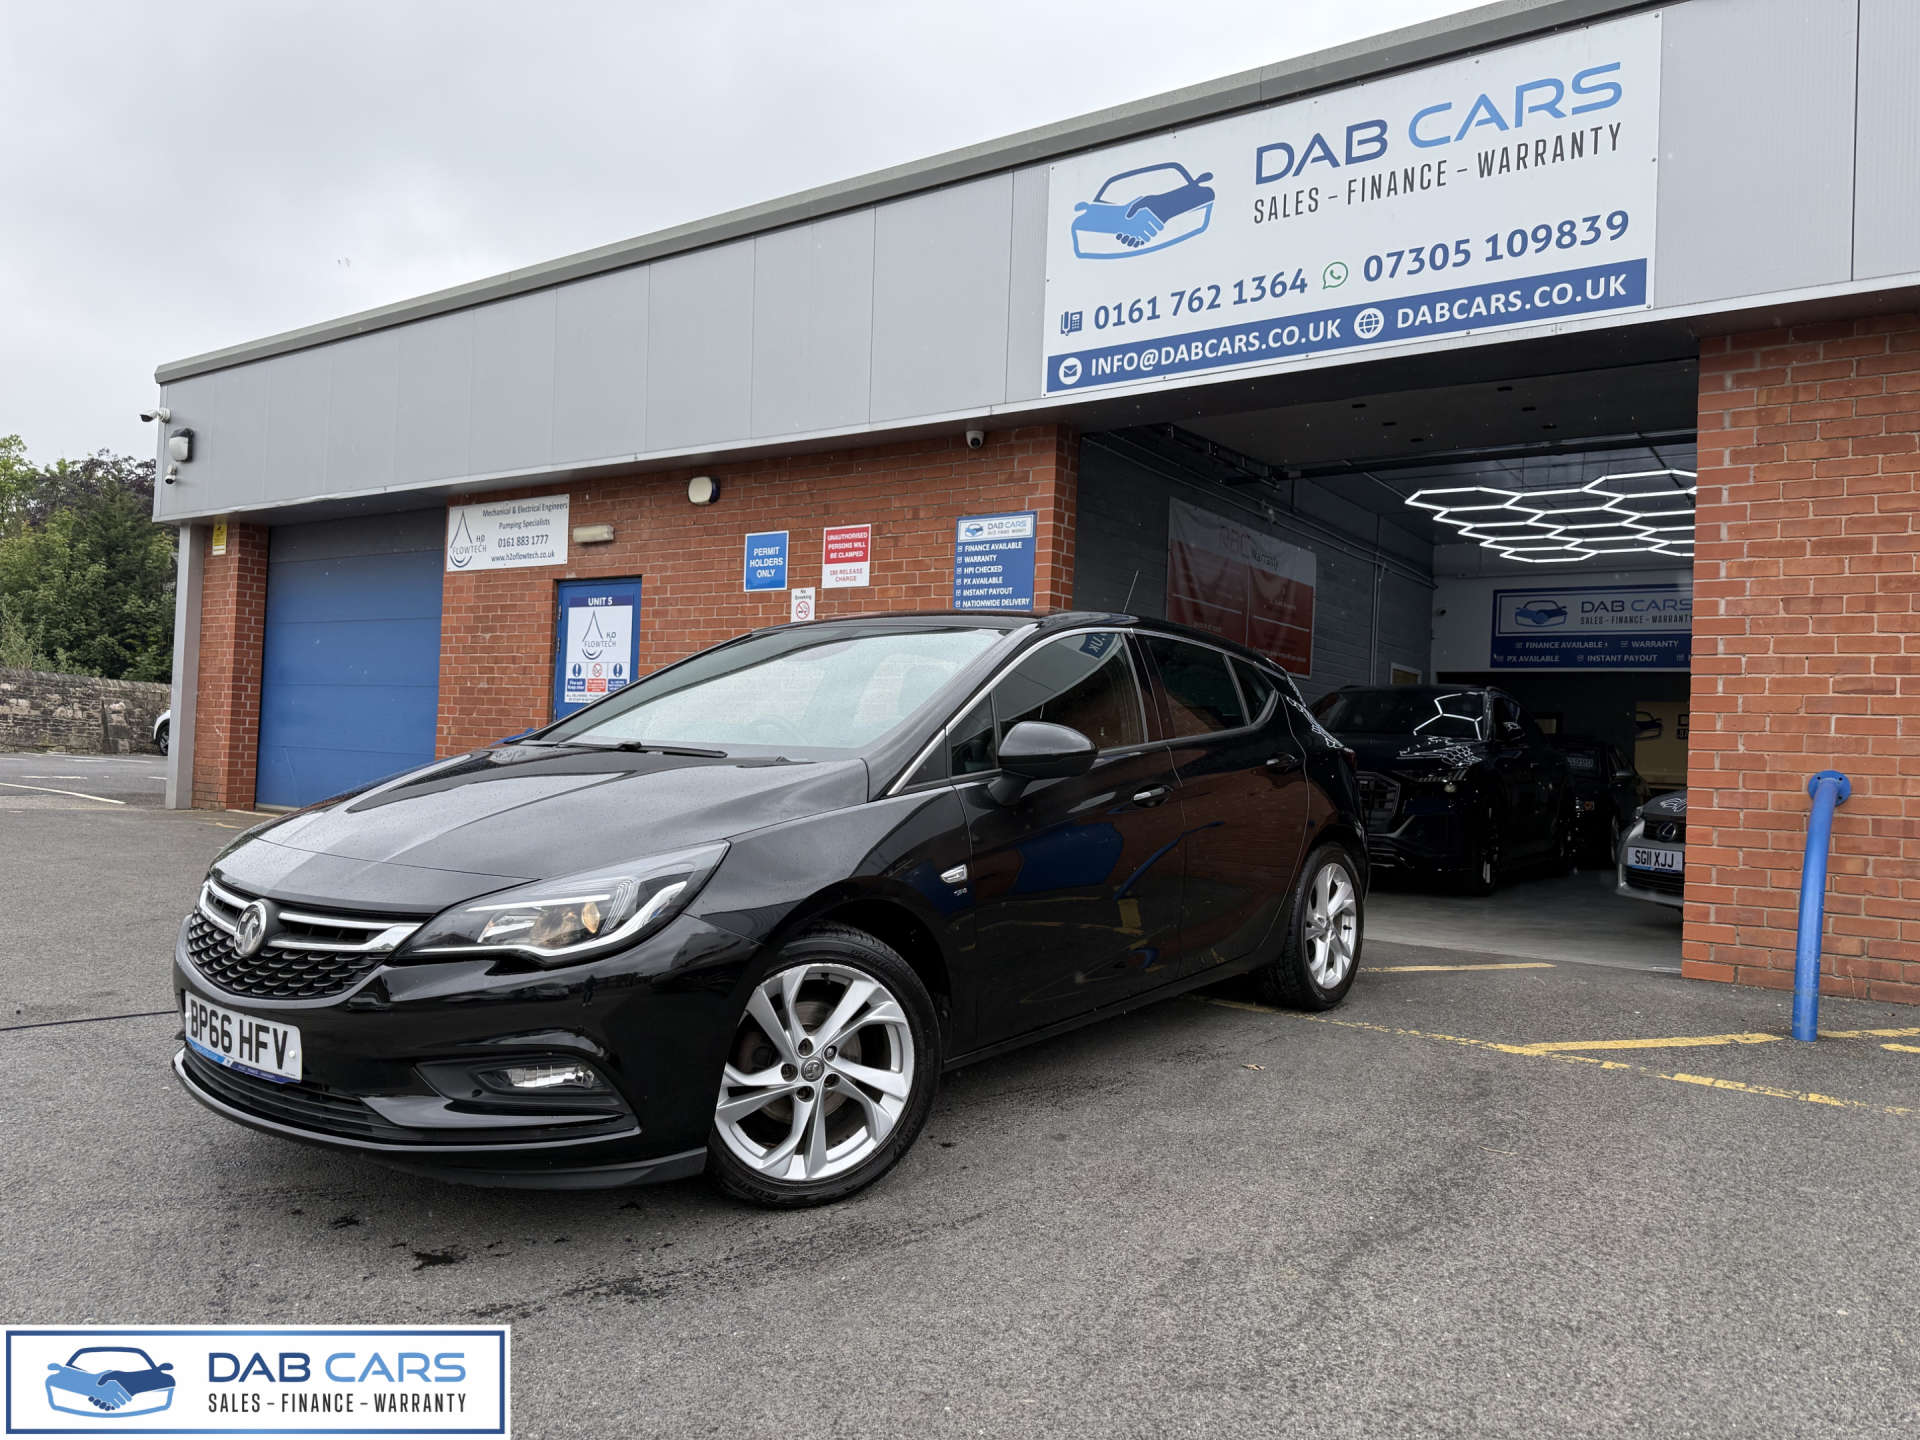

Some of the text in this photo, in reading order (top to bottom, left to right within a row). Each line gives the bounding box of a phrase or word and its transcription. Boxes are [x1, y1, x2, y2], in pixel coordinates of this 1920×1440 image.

[1255, 62, 1623, 185] DAB CARS
[1254, 186, 1320, 224] SALES
[1347, 159, 1448, 206] FINANCE
[1477, 122, 1624, 180] WARRANTY
[1094, 210, 1630, 330] 0161 762 1364 07305 109839
[1091, 274, 1627, 377] INFO@DABCARS.CO.UK DABCARS.CO.UK
[498, 534, 549, 548] 0161 883 1777
[754, 547, 780, 556] PERMIT
[965, 542, 1023, 553] FINANCE AVAILABLE
[750, 558, 784, 568] HOLDERS
[965, 555, 998, 563] WARRANTY
[756, 569, 776, 578] ONLY
[963, 587, 1013, 596] INSTANT PAYOUT
[588, 597, 607, 606] UNIT
[1581, 599, 1693, 614] DAB CARS
[1612, 615, 1643, 625] FINANCE
[1561, 641, 1603, 649] AVAILABLE
[1632, 640, 1679, 648] WARRANTY
[1587, 655, 1622, 663] INSTANT
[1624, 654, 1658, 662] PAYOUT
[1654, 852, 1675, 868] XJJ
[191, 998, 288, 1070] BP66 HFV
